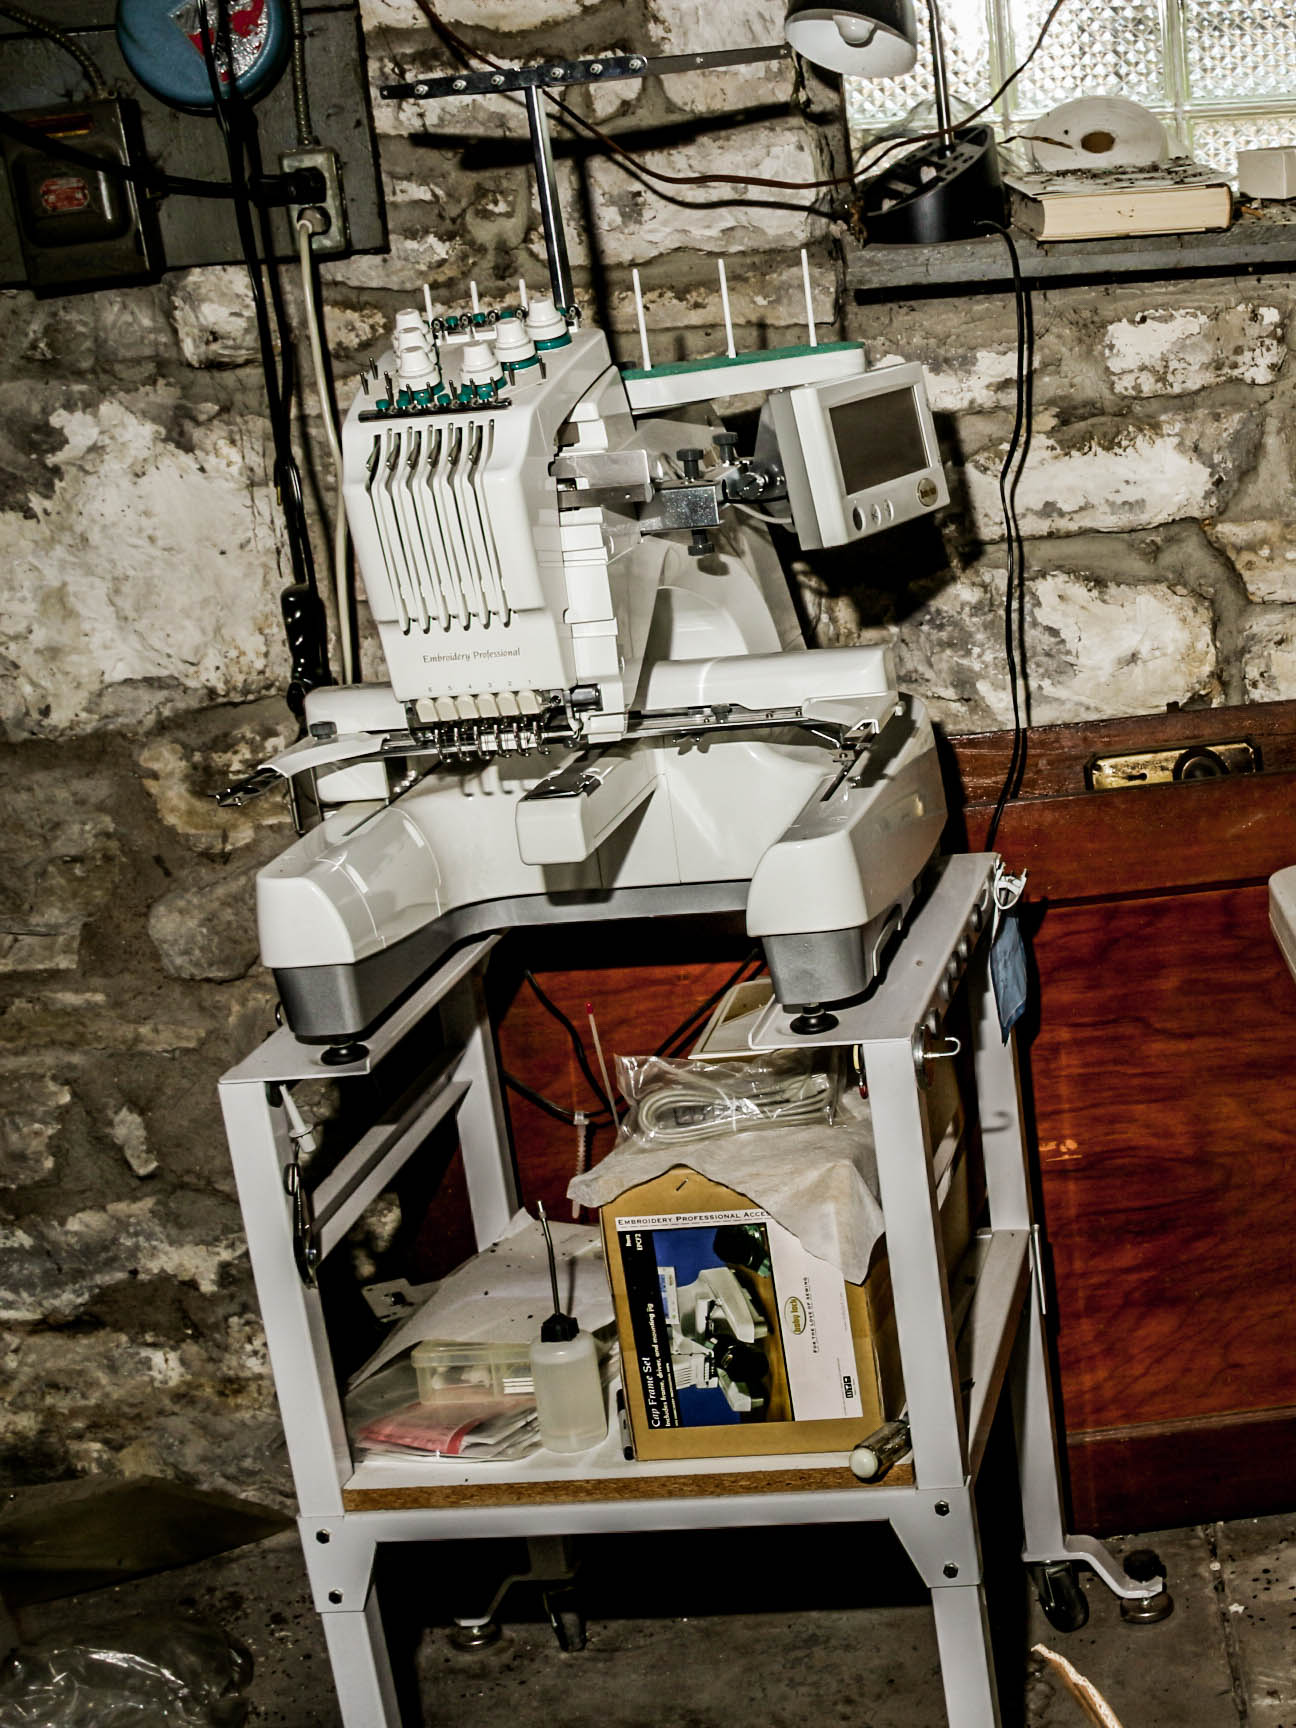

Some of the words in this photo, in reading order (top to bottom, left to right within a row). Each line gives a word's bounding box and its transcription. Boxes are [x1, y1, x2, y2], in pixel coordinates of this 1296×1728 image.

[422, 653, 471, 663] Embroidery
[473, 648, 520, 660] Professional
[618, 1217, 673, 1226] EMBROIDERY
[676, 1213, 740, 1222] PROFESSIONAL
[649, 1314, 658, 1343] mounting
[652, 1345, 660, 1357] and
[641, 1357, 652, 1373] Set
[646, 1375, 658, 1405] Frame
[652, 1408, 661, 1428] Cap
[662, 1402, 671, 1427] Includes
